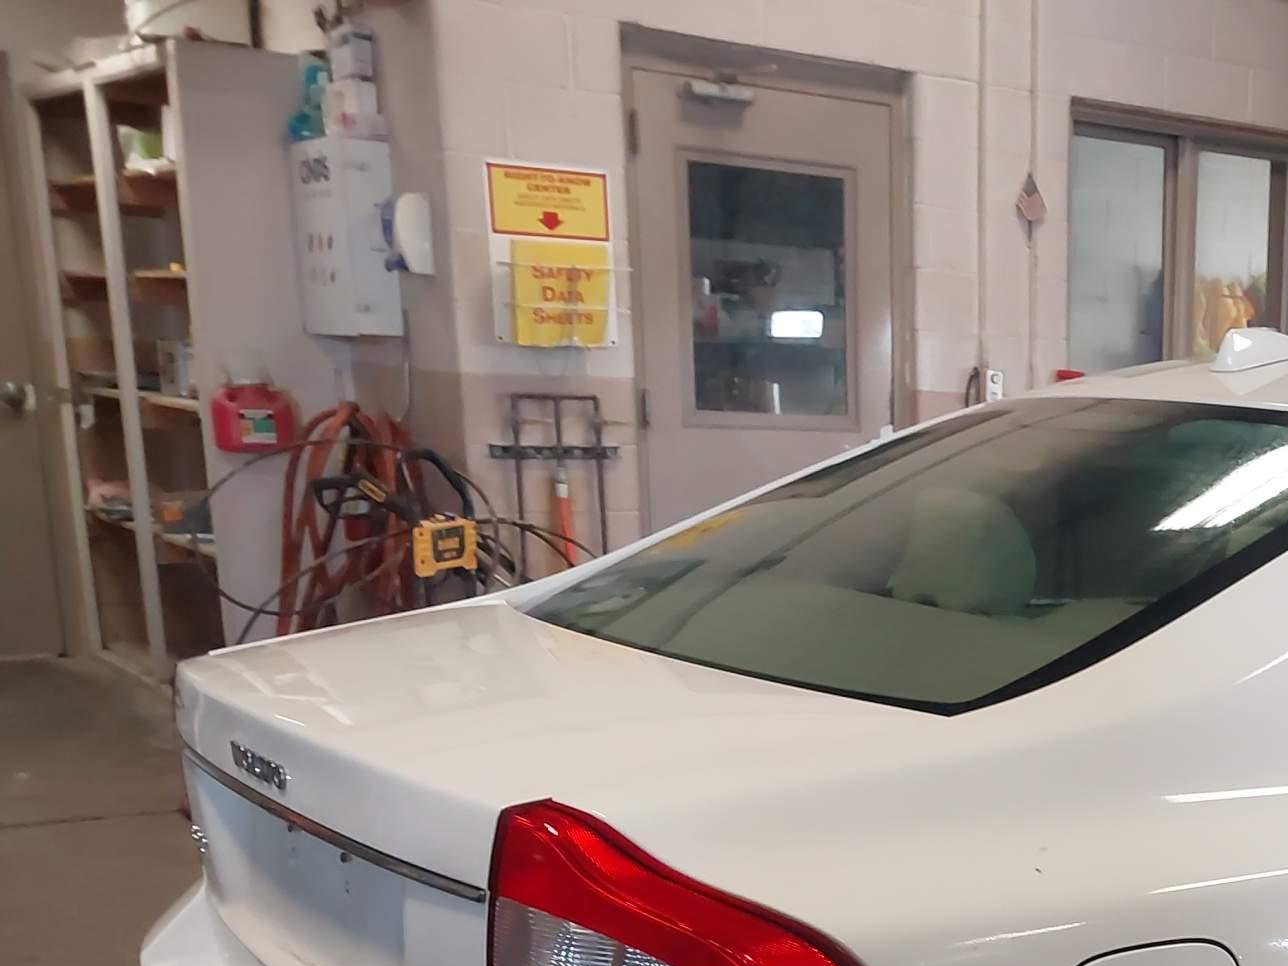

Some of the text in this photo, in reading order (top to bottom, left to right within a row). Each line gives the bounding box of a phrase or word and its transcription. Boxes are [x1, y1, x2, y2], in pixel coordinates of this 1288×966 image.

[531, 265, 593, 283] SAFETY
[542, 286, 585, 303] DATA
[229, 740, 288, 790] VOLVO
